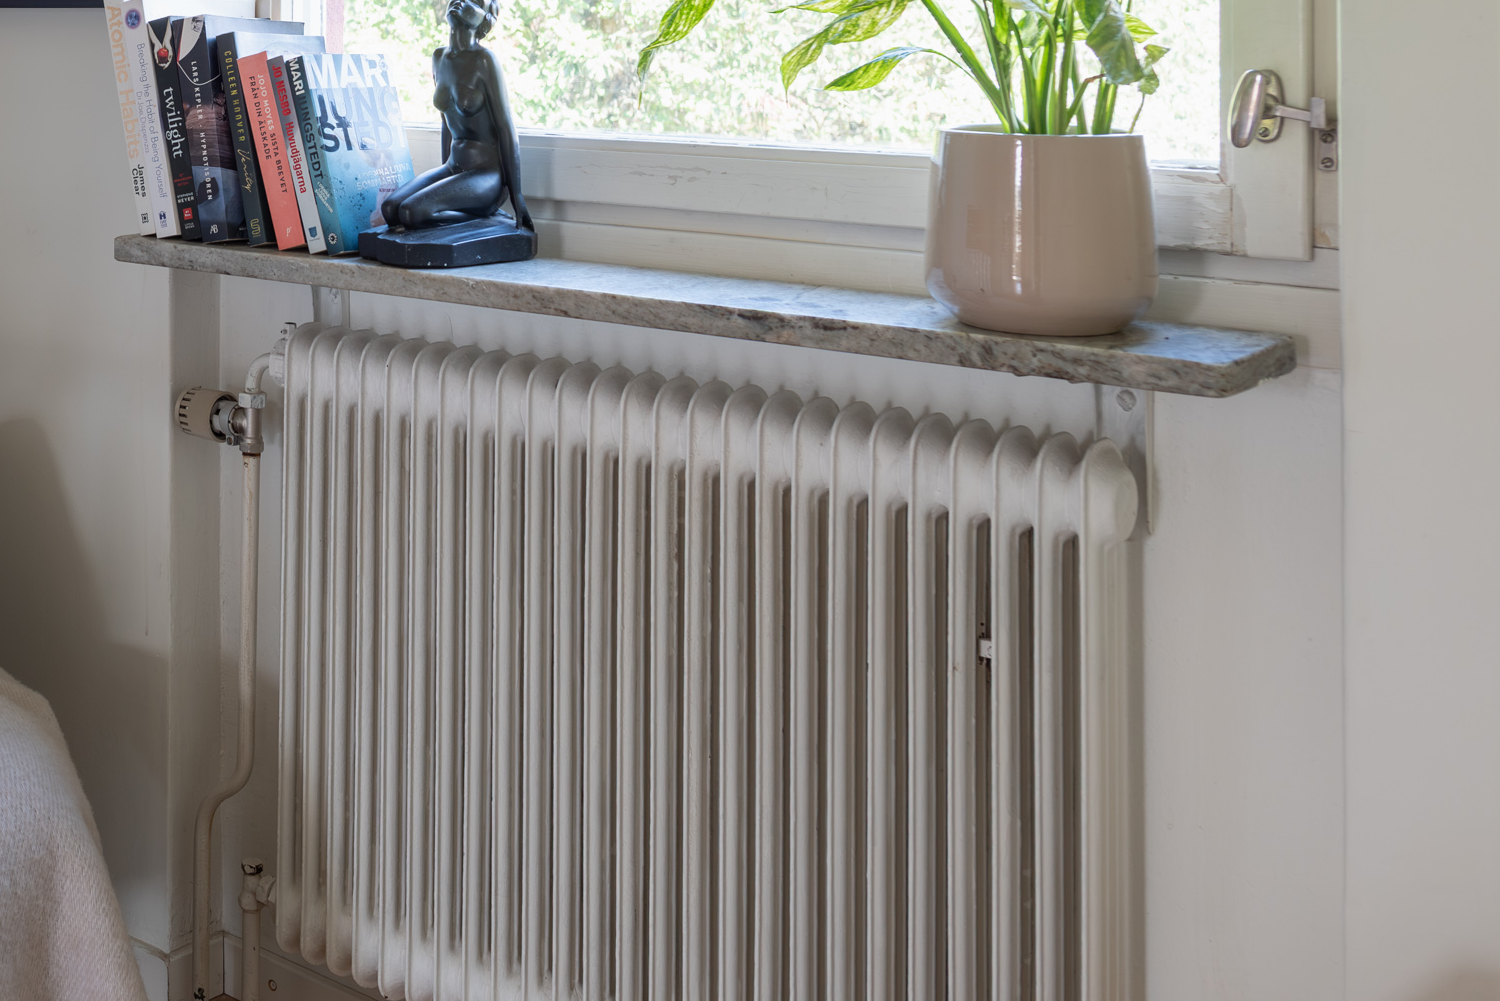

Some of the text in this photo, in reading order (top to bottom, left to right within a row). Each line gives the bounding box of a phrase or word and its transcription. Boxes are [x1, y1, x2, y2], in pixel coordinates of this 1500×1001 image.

[106, 6, 140, 159] Atomic Habits
[137, 43, 168, 198] Breaking the Habit of Being Yourself
[163, 87, 186, 158] twilight
[224, 50, 246, 142] COLLEEN HOOVER
[248, 76, 260, 101] FRÅN
[258, 120, 272, 160] ÄLSKADE
[272, 64, 292, 117] JO NESBØ
[288, 58, 324, 180] MARI JUNGSTEDT
[191, 61, 213, 200] LARS KEPLER HYPNOTISÖREN
[258, 74, 288, 193] JOJO MOYES SISTA BREVET
[285, 121, 307, 194] Huvudjägarna
[132, 168, 140, 196] Clear
[138, 164, 147, 198] James
